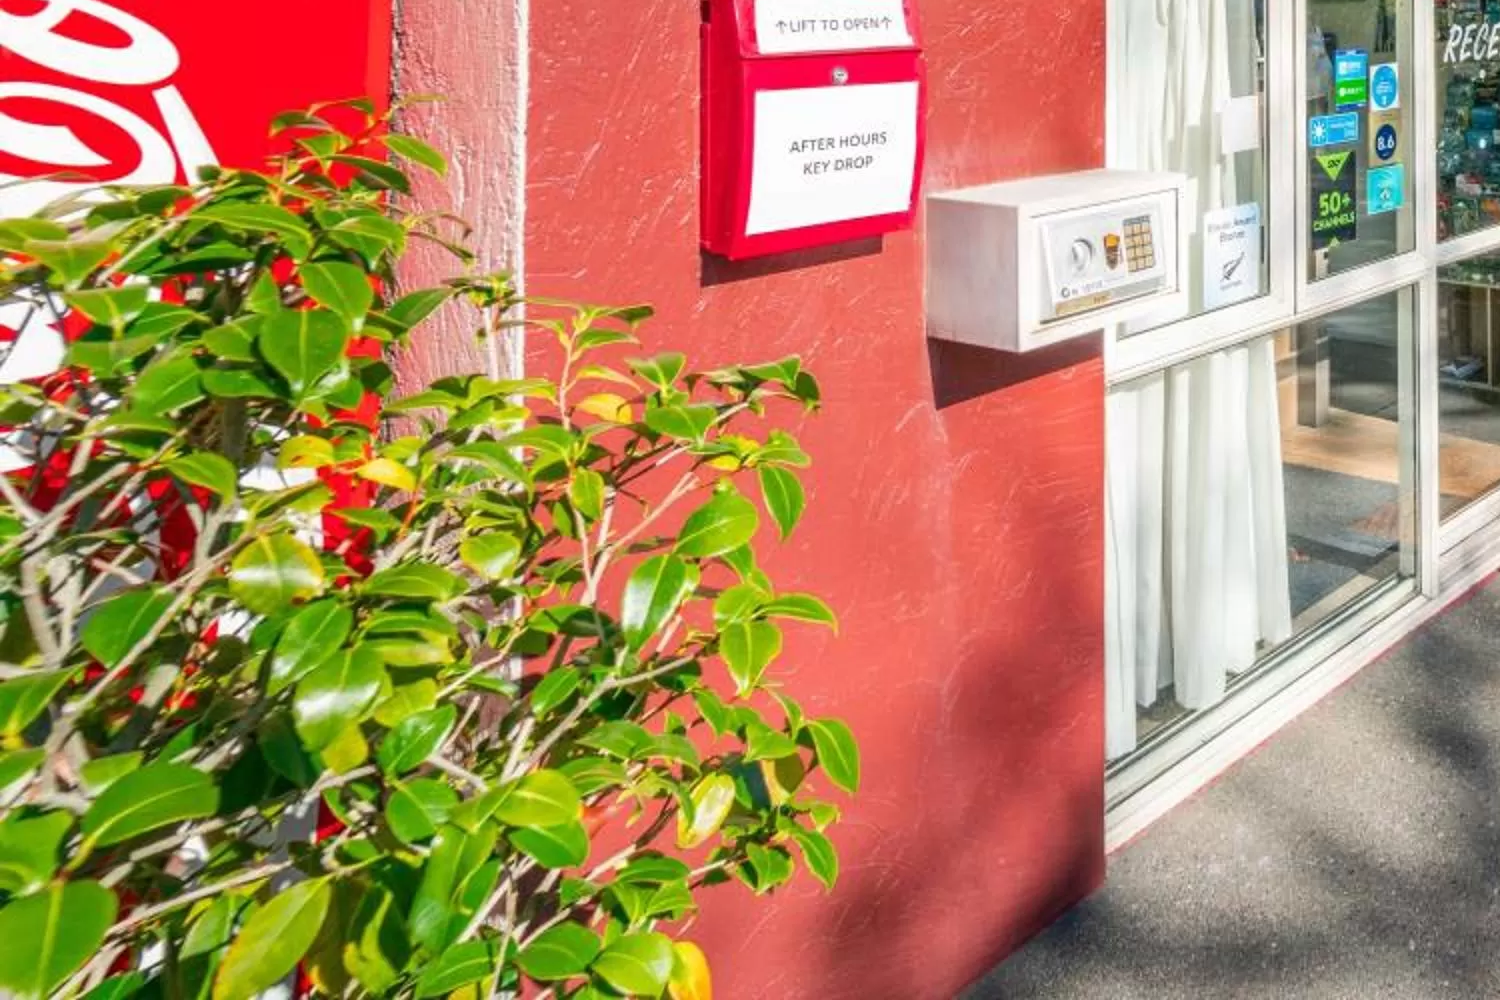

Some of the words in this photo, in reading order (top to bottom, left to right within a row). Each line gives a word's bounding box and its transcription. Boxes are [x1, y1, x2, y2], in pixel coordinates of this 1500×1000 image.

[789, 18, 816, 32] LIFT
[821, 17, 839, 31] TO
[843, 16, 879, 30] OPEN
[789, 137, 835, 153] AFTER
[839, 131, 887, 147] HOURS
[1377, 135, 1394, 150] 8.6
[803, 159, 830, 175] KEY
[834, 155, 873, 171] DROP
[1319, 191, 1351, 217] 50+
[1312, 211, 1354, 232] CHANNELS
